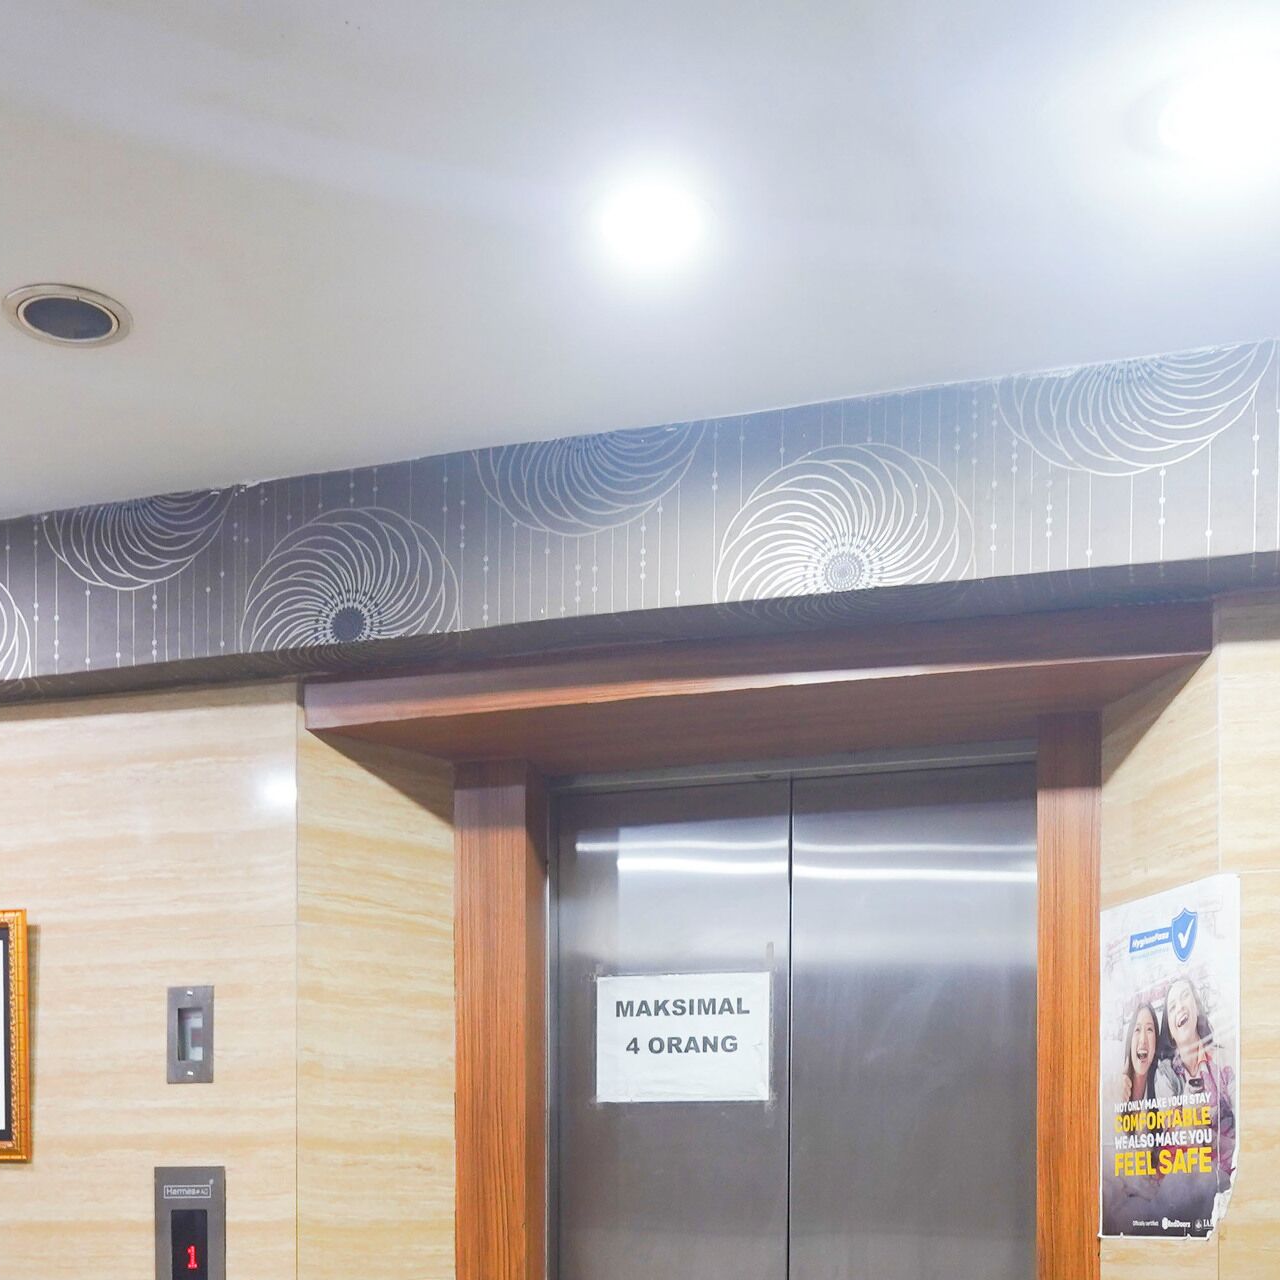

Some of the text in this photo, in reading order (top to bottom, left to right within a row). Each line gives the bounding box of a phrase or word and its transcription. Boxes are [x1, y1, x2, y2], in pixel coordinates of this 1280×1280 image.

[615, 997, 751, 1018] MAKSIMAL
[625, 1035, 738, 1055] 4 ORANG
[1114, 1092, 1211, 1113] NOT ONLY MAKE YOUR STAY
[1114, 1106, 1211, 1133] COMFORTABLE
[1114, 1128, 1212, 1150] WE ALSO MAKE YOU
[1114, 1146, 1212, 1177] FEEL SAFE
[187, 1245, 198, 1269] 1
